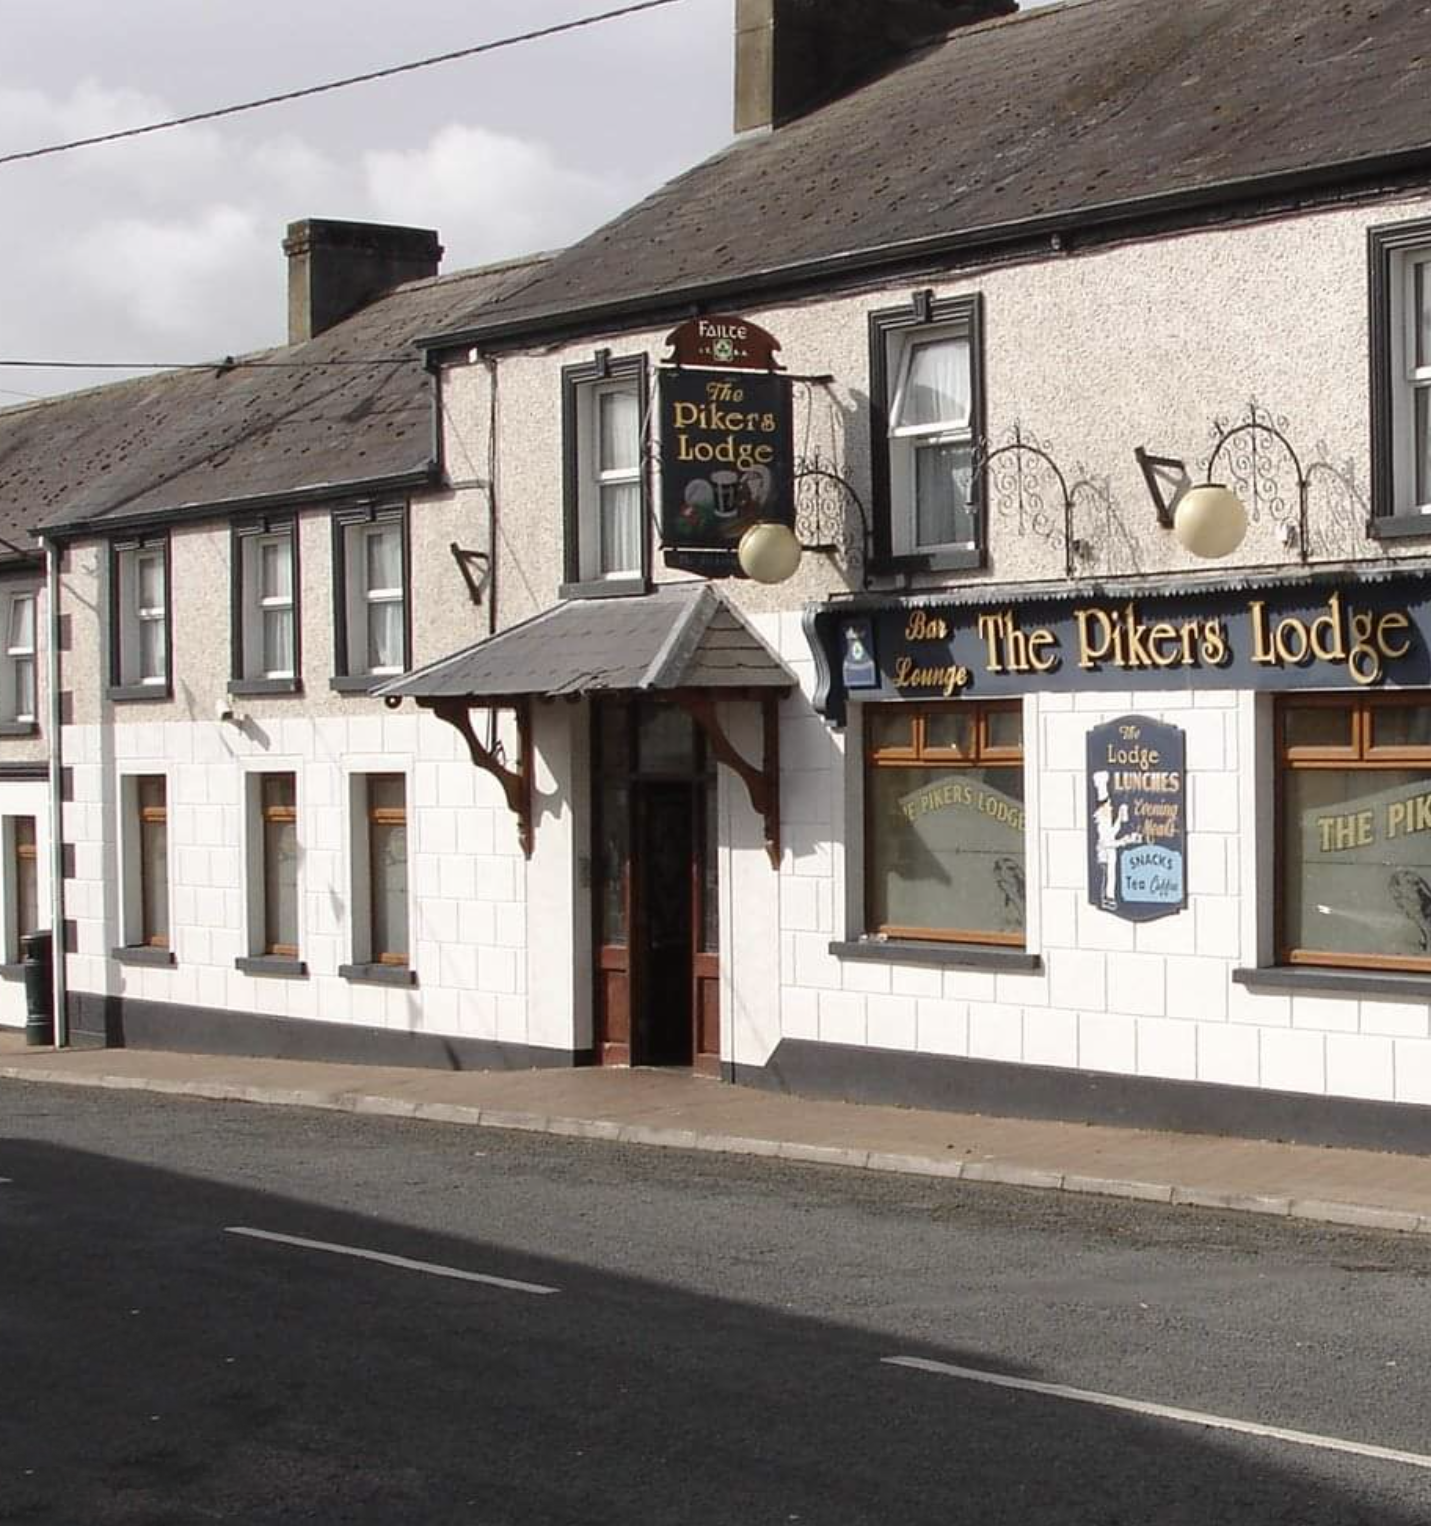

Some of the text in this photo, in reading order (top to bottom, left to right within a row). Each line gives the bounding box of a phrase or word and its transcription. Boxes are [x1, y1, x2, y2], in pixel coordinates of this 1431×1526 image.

[706, 382, 743, 402] The
[673, 402, 775, 432] Pikers
[677, 434, 774, 471] Lodge
[905, 610, 949, 640] Bar
[979, 591, 1411, 684] The Pikers Lodge
[893, 656, 968, 696] Lounge
[1107, 743, 1160, 771] Lodge
[1114, 771, 1180, 792] LUNCHES
[920, 784, 972, 813] PIKERS
[1317, 808, 1374, 853] THE
[1129, 853, 1173, 870] SNACKS
[1126, 875, 1145, 891] Tea
